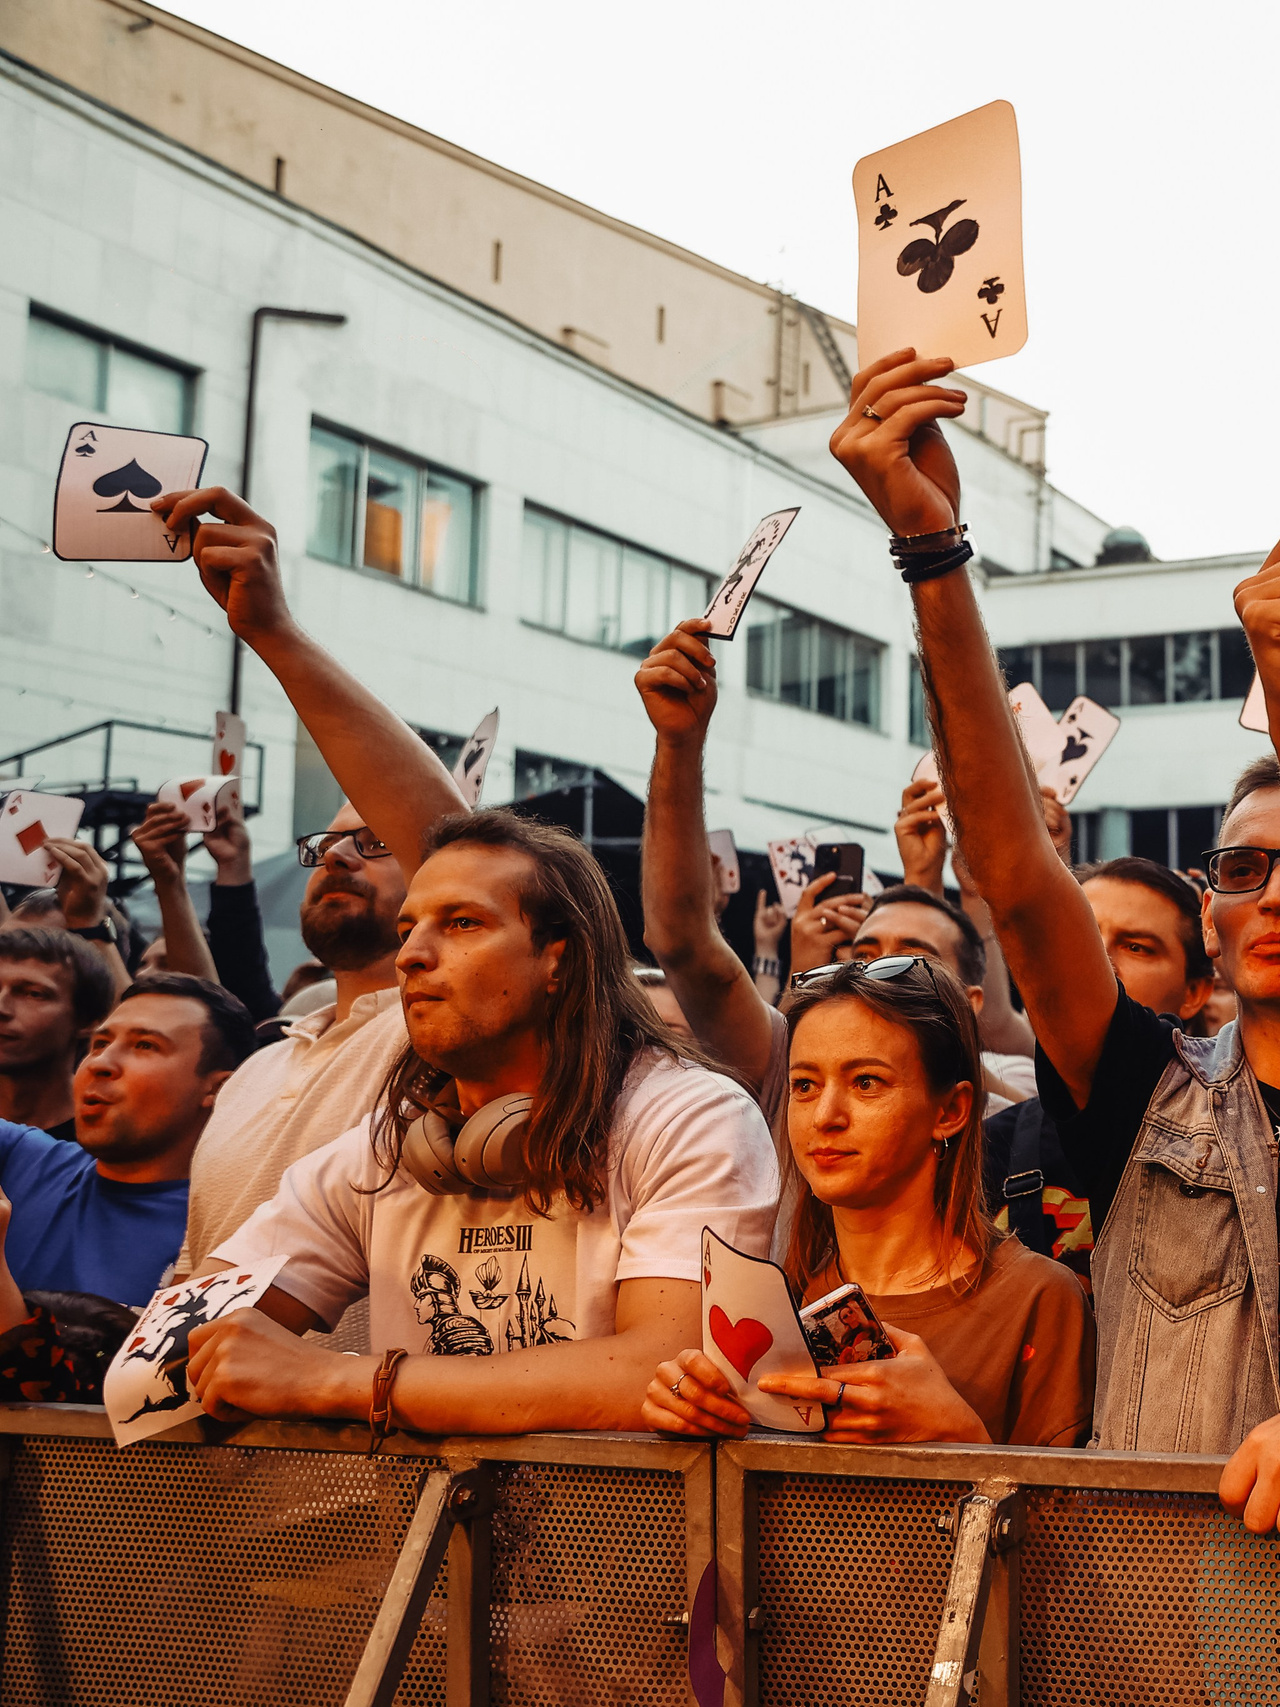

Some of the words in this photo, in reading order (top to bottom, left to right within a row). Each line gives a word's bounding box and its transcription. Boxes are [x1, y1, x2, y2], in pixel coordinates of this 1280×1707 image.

[875, 173, 894, 203] A
[980, 308, 1003, 339] A
[79, 430, 98, 441] A
[163, 535, 181, 553] A
[727, 592, 747, 632] JOKER
[458, 1225, 515, 1253] HEROES
[515, 1225, 533, 1251] III
[704, 1238, 712, 1265] A
[793, 1406, 813, 1426] A
